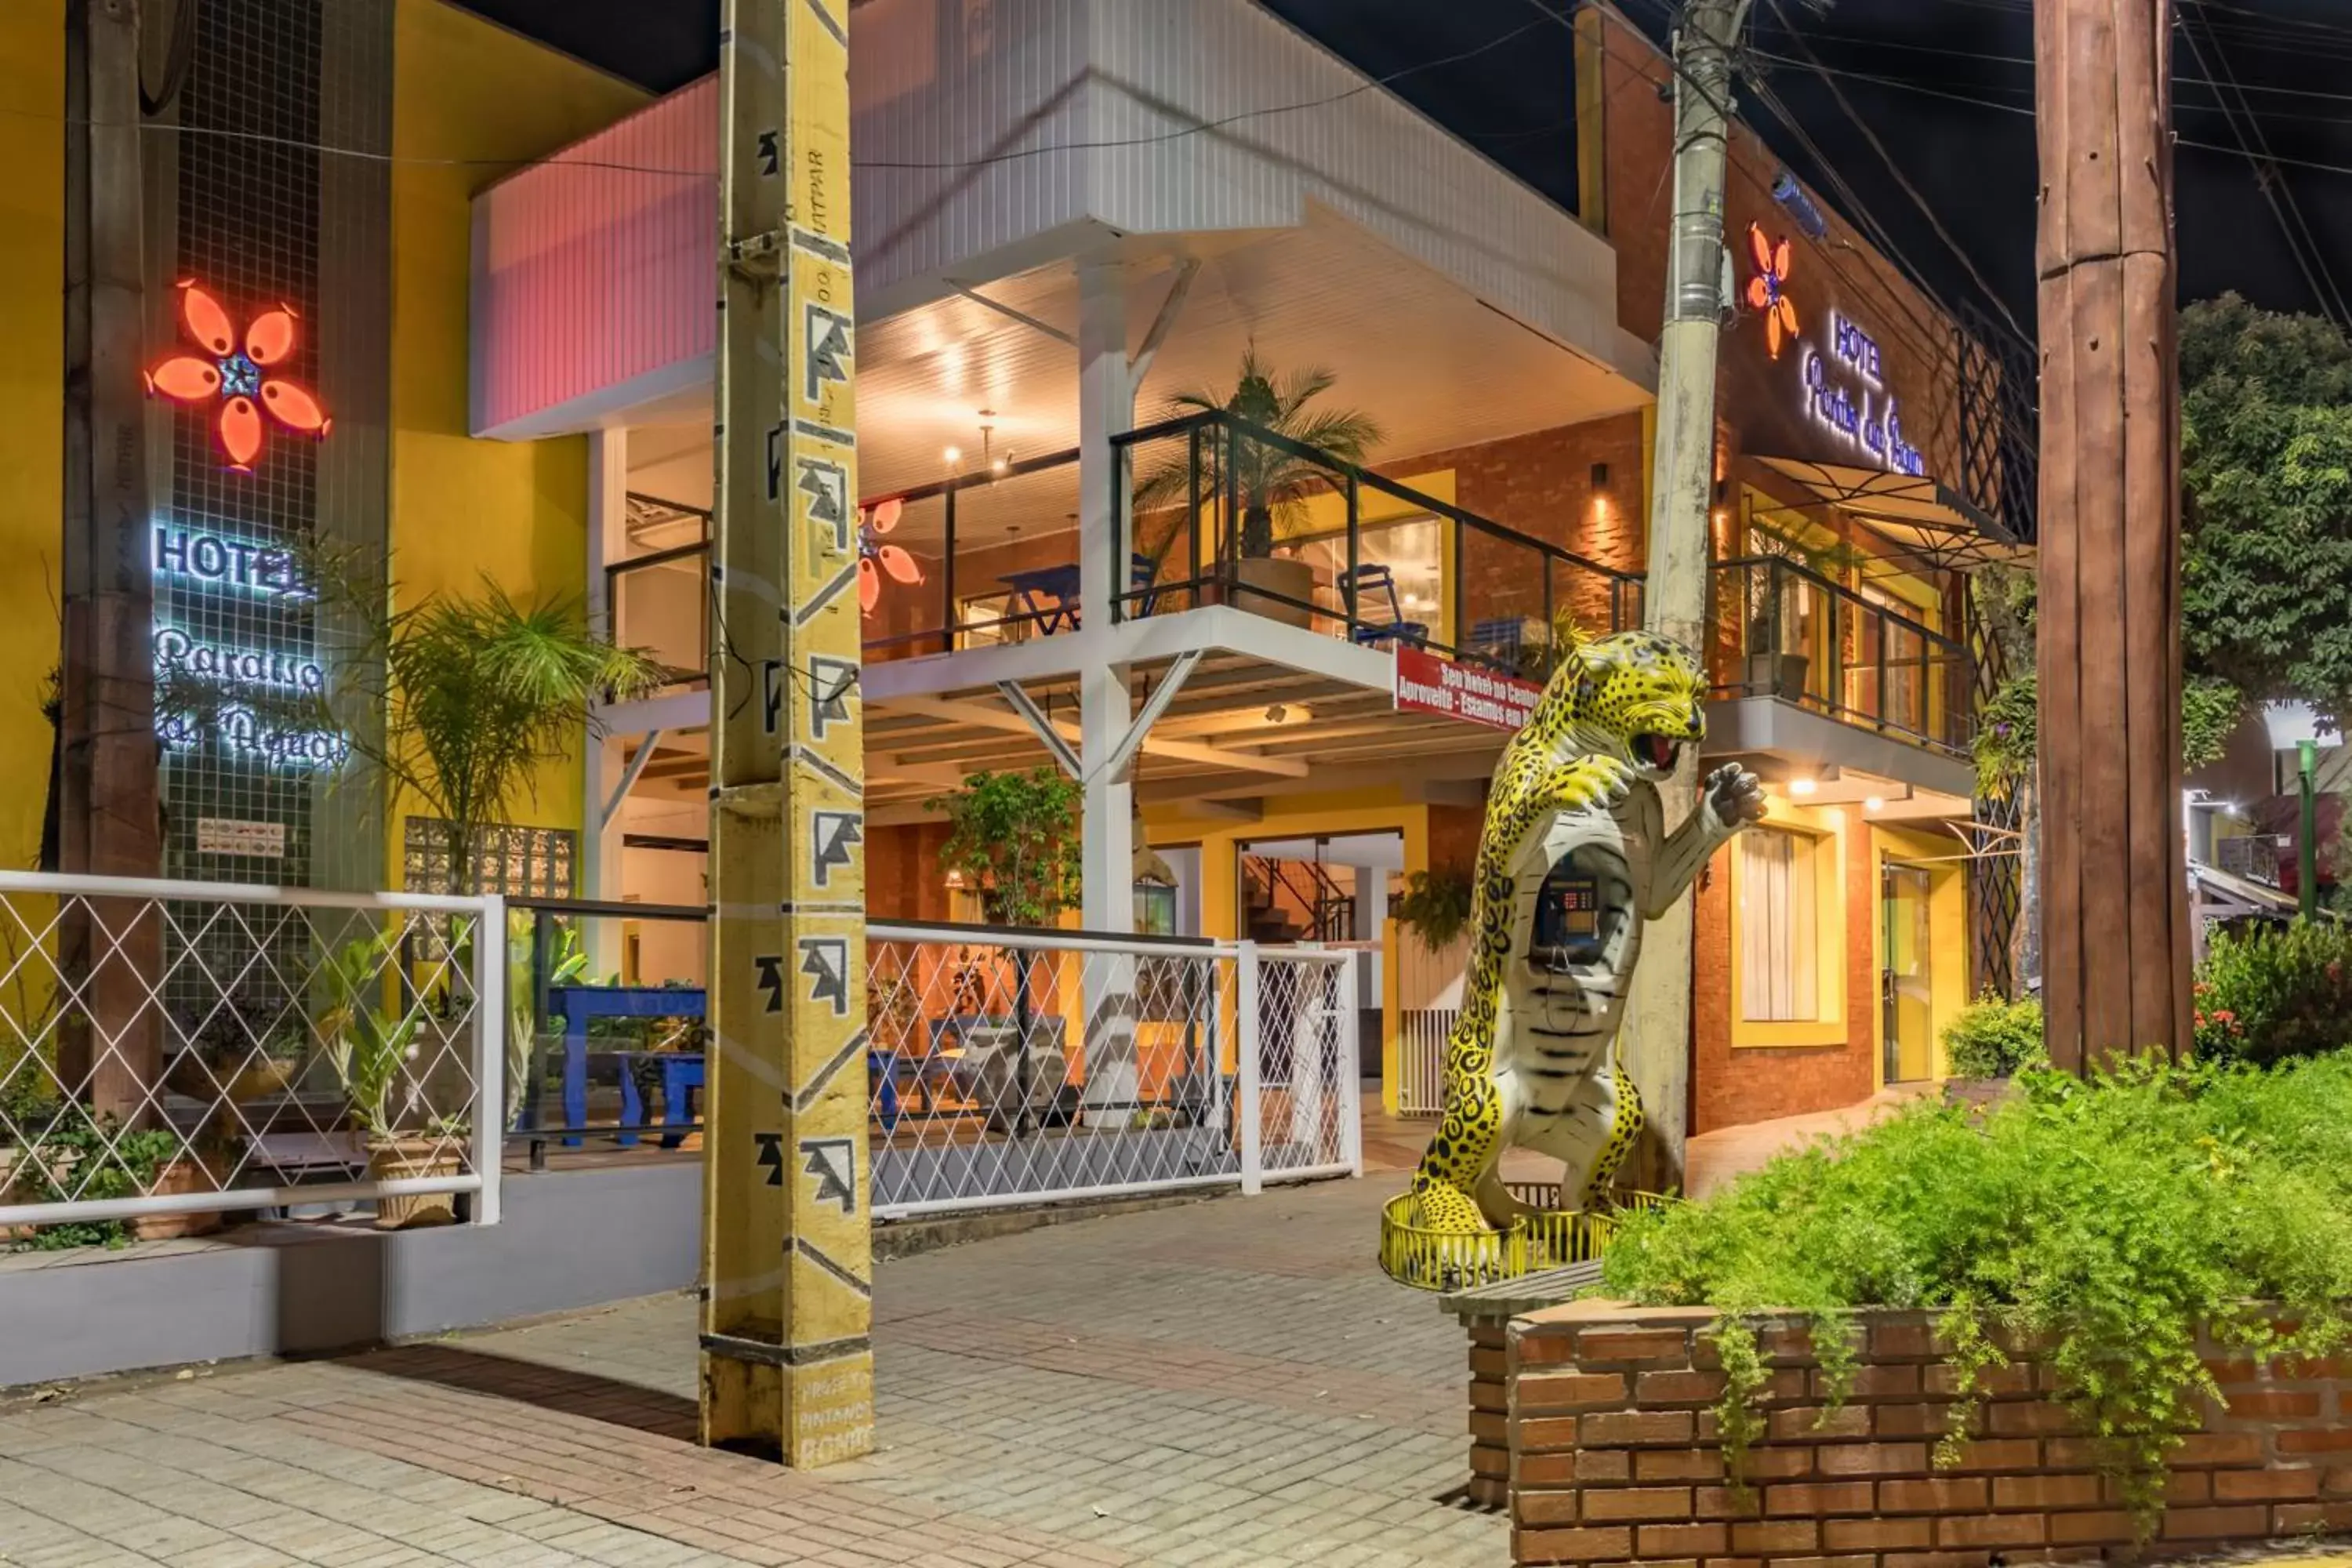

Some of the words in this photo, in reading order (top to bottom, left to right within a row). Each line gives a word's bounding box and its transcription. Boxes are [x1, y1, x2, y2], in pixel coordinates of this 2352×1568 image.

[1830, 308, 1884, 392] HOTEL
[1440, 662, 1463, 688] Seu
[1464, 669, 1493, 696] Hotel
[1494, 679, 1506, 700] no
[1460, 691, 1505, 724] Estamos
[1505, 707, 1522, 728] em
